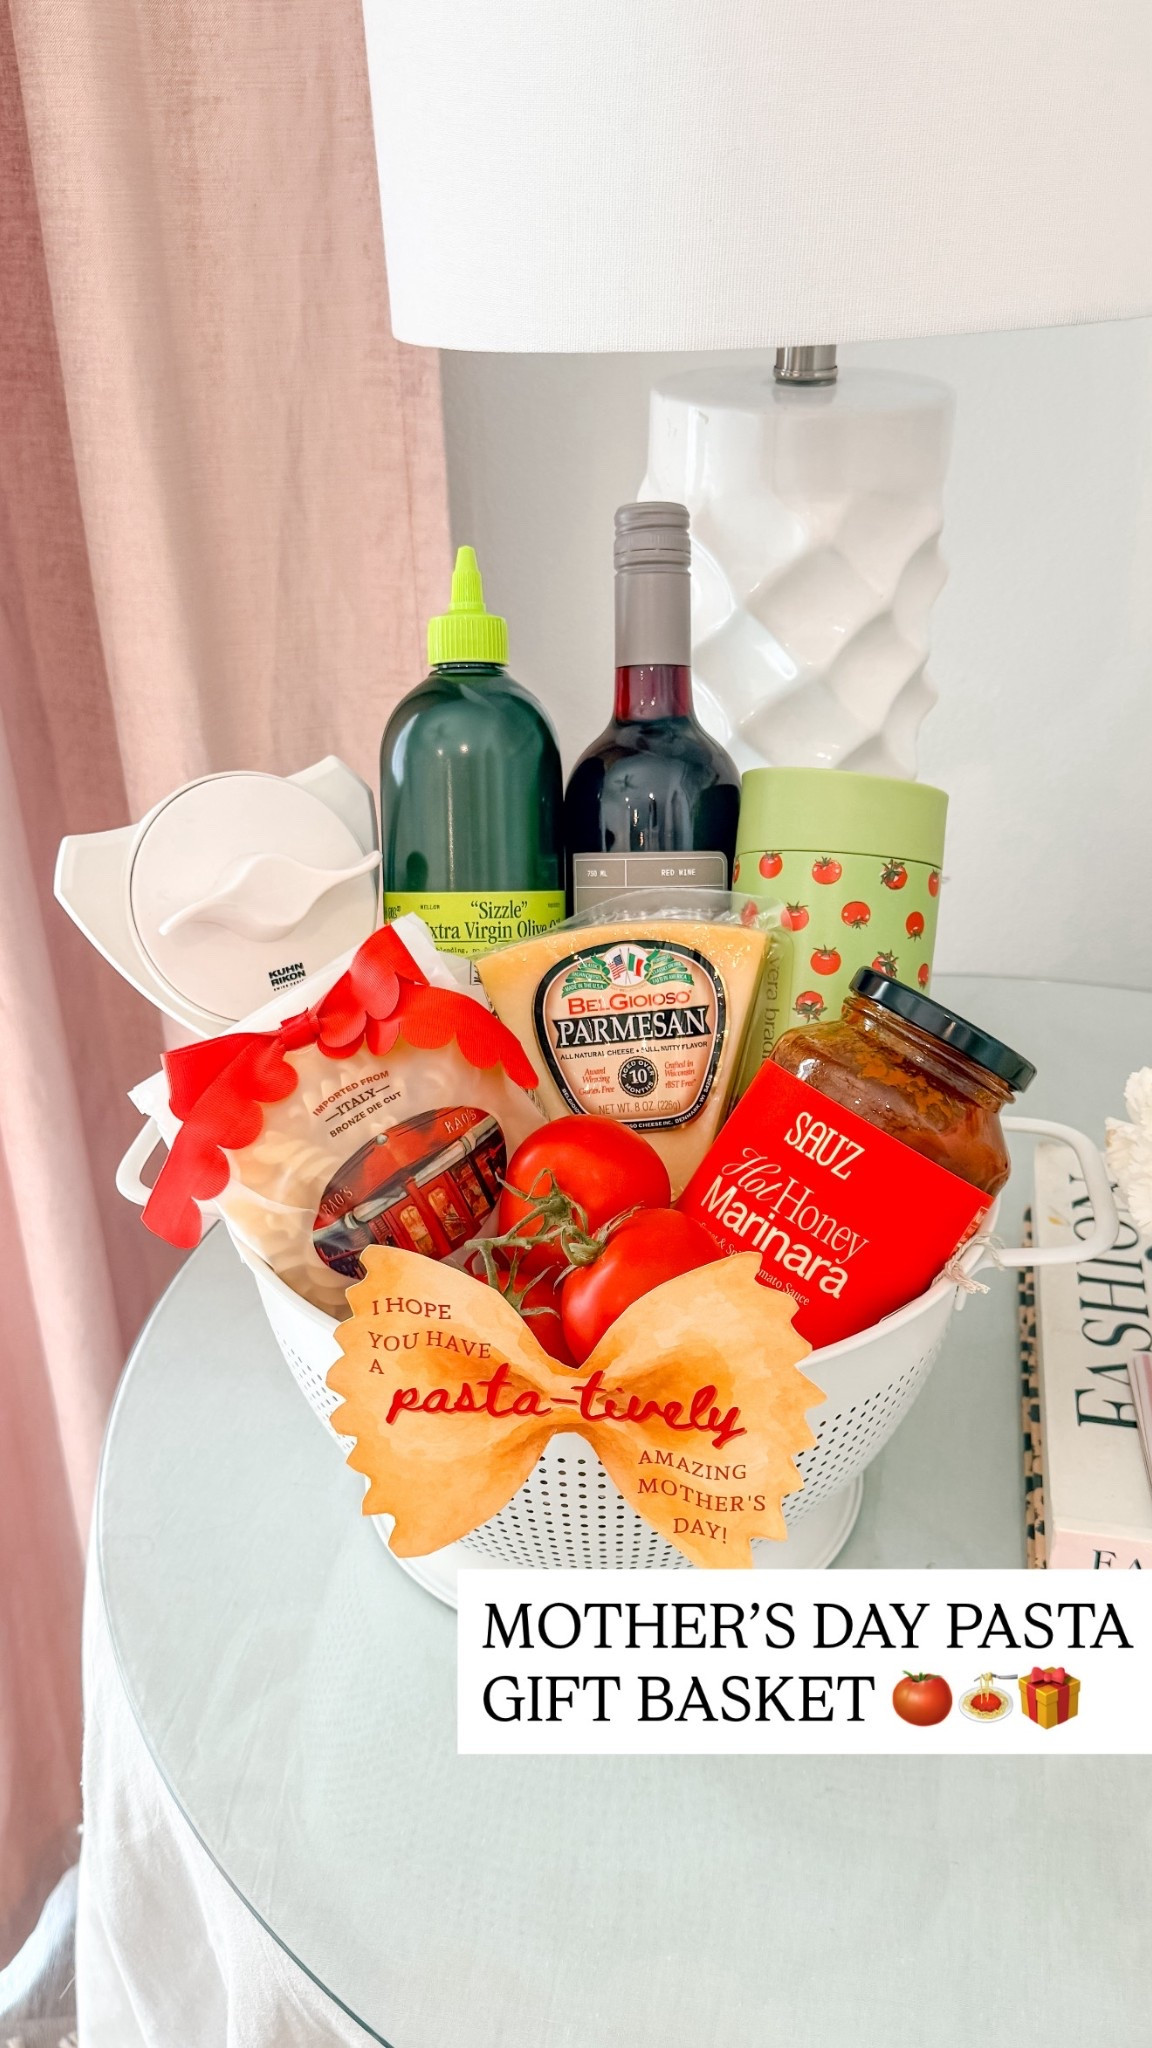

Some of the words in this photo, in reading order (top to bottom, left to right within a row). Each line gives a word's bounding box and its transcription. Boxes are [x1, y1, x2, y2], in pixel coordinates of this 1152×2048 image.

[471, 900, 527, 920] “Sizzle”
[425, 921, 461, 939] xtra
[464, 921, 512, 944] Virgin
[268, 962, 304, 979] KUHN
[271, 970, 307, 987] RIKON
[558, 1008, 707, 1046] PARMESAN
[560, 1053, 573, 1061] ALL
[607, 1047, 634, 1056] CHEESE
[661, 1045, 681, 1053] NUTTY
[681, 1041, 708, 1050] FLAVOR
[621, 1060, 636, 1079] AGED
[638, 1060, 655, 1076] OVER
[629, 1068, 648, 1084] 10
[312, 1082, 359, 1117] IMPORTED
[359, 1070, 389, 1086] FROM
[625, 1081, 654, 1094] MONTHS
[329, 1111, 366, 1138] BRONZE
[366, 1101, 383, 1115] DIE
[383, 1091, 402, 1104] CUT
[443, 1108, 478, 1134] RAO'S
[599, 1104, 615, 1115] NET
[616, 1102, 632, 1113] WT.
[635, 1101, 640, 1111] 8
[642, 1101, 657, 1111] OZ.
[784, 1111, 865, 1181] SAUZ
[321, 1185, 354, 1218] RAO'S
[721, 1147, 783, 1201] Hot
[770, 1175, 870, 1265] Honey
[700, 1174, 849, 1300] Marinara
[372, 1299, 380, 1316] I
[385, 1297, 452, 1320] HOPE
[367, 1330, 420, 1352] YOU
[426, 1330, 492, 1359] HAVE
[368, 1358, 385, 1375] A
[386, 1362, 748, 1450] pasta-tively
[638, 1449, 747, 1481] AMAZING
[637, 1477, 766, 1512] MOTHER'S
[672, 1516, 728, 1545] DAY!
